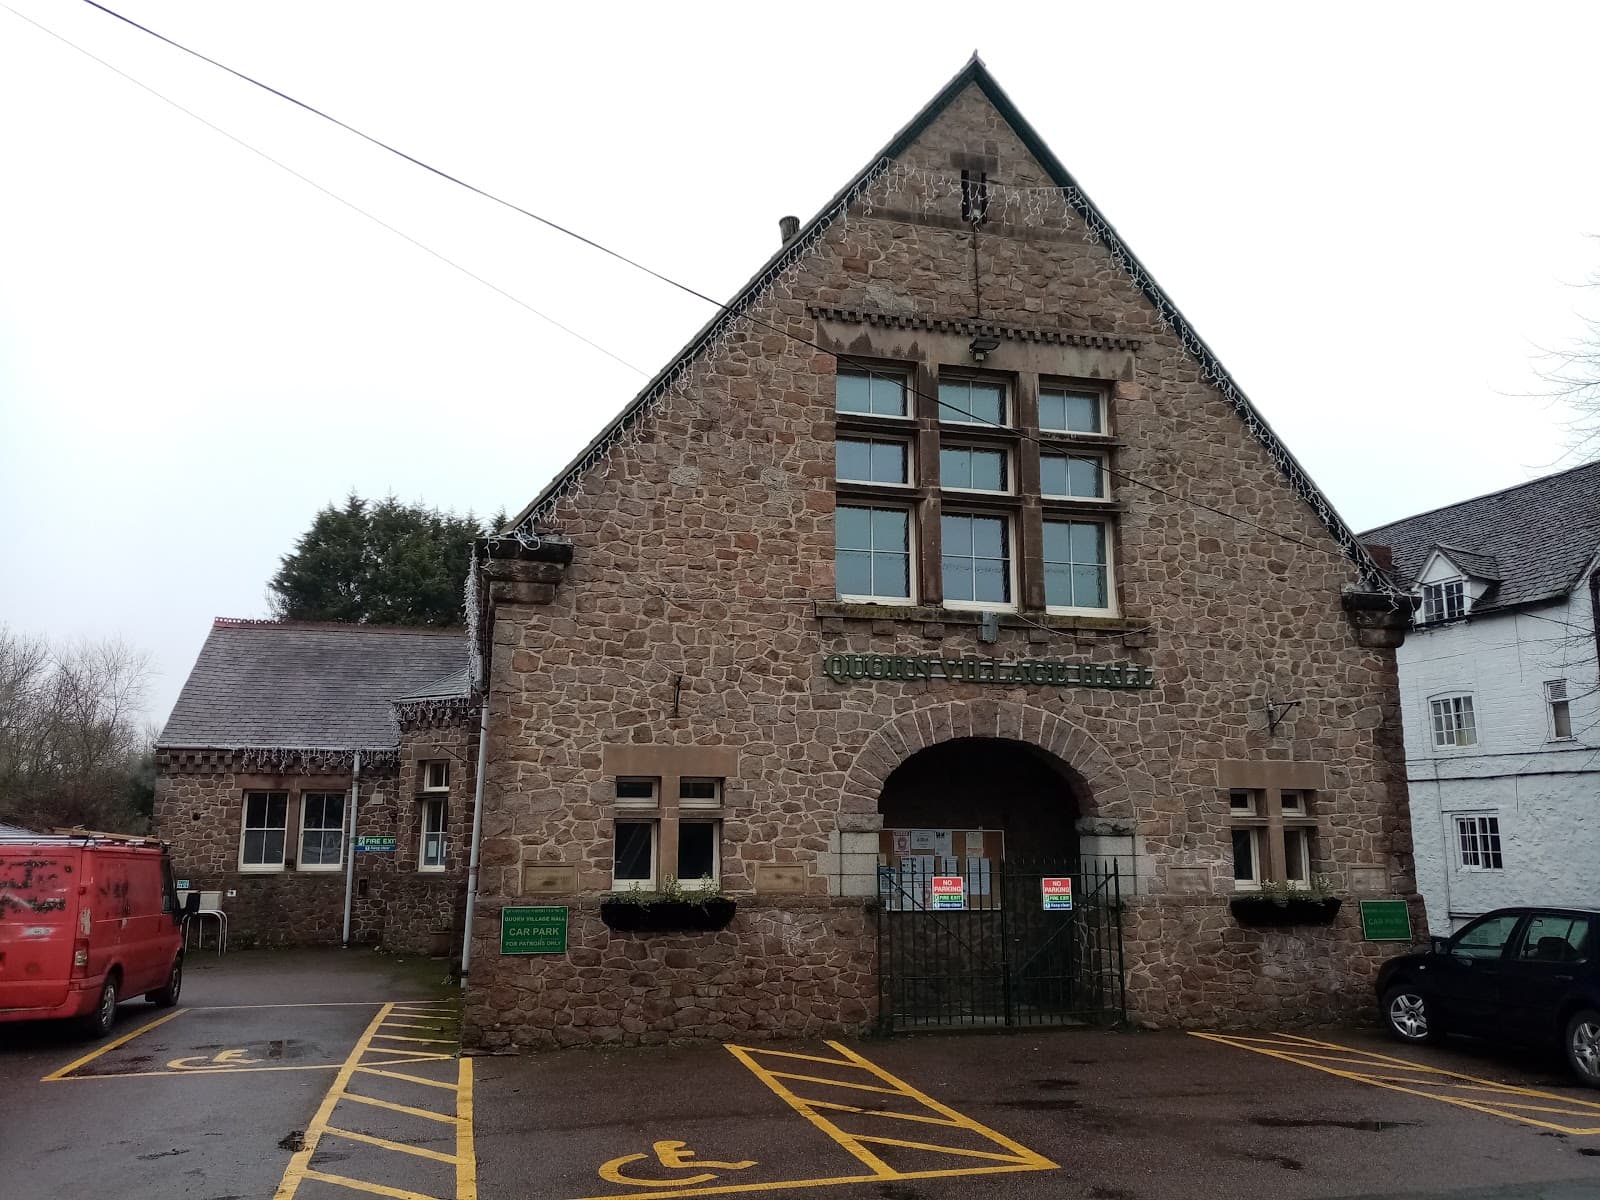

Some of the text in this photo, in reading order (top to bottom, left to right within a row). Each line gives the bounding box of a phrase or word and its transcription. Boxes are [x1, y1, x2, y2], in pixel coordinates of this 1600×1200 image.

[824, 653, 1154, 688] QUORN VILLAGE HALL
[509, 927, 560, 936] CAR PARK
